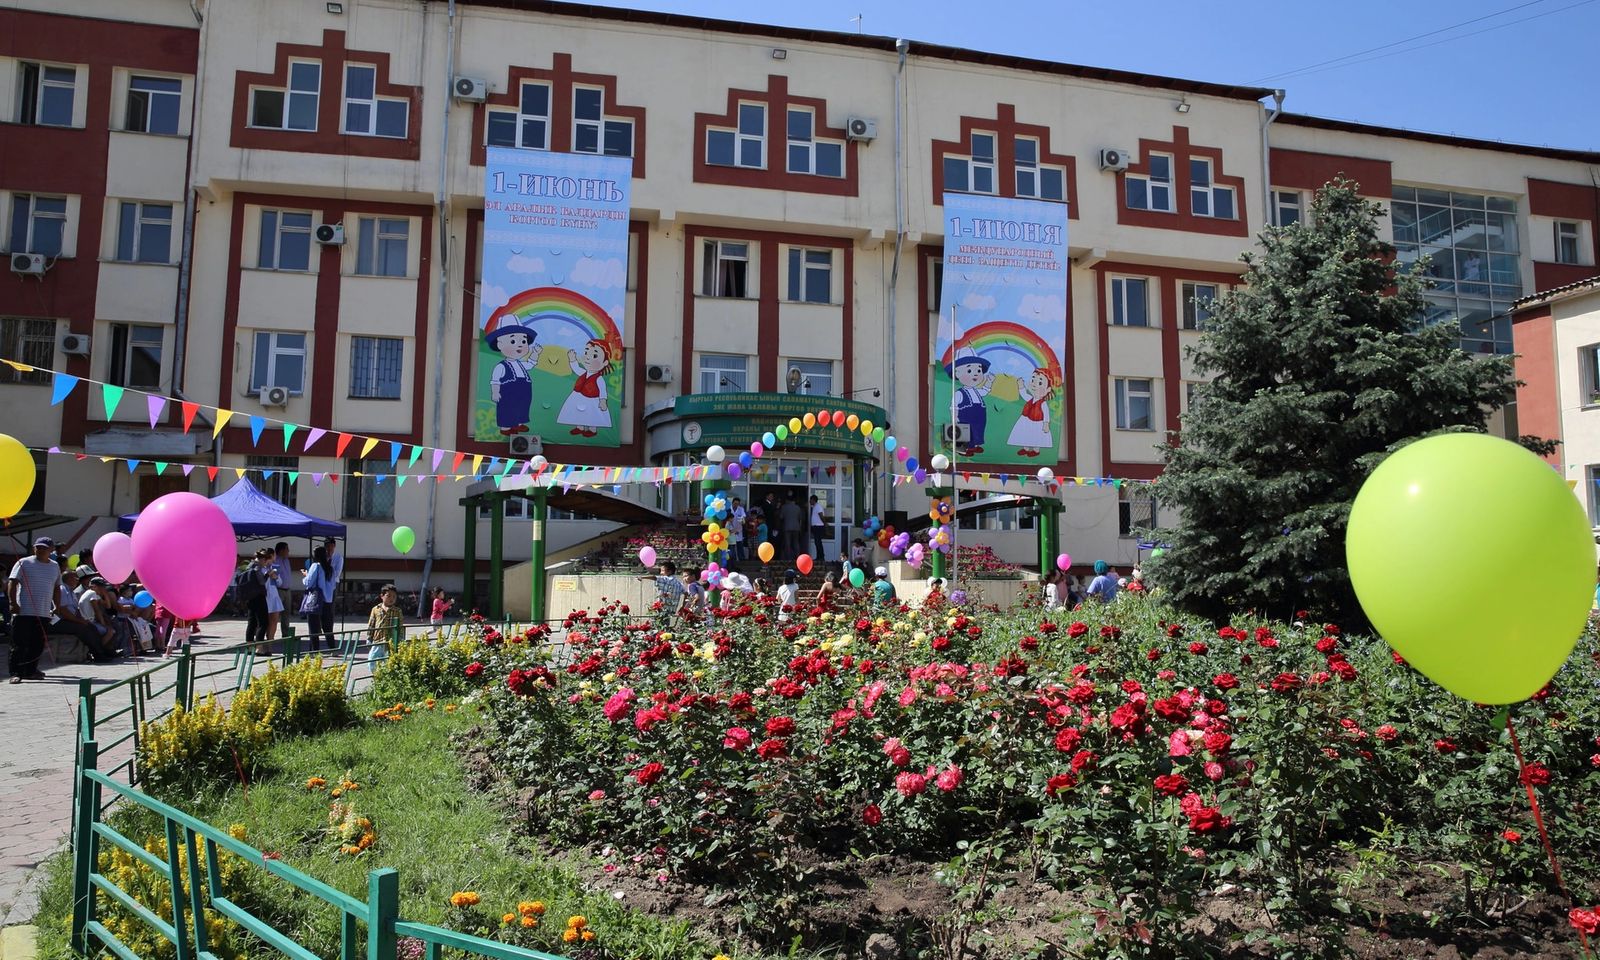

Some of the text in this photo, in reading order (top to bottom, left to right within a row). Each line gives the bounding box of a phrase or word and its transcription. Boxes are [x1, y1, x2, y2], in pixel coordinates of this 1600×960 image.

[493, 172, 624, 202] 1-ИЮНЬ
[505, 203, 557, 214] АРАЛЫК
[951, 217, 1062, 245] 1-ИЮНЯ
[960, 245, 1054, 259] МЕЖДУНАРОДНЫЙ
[949, 255, 975, 264] ДЕНЬ
[979, 257, 1024, 268] ЗАЩИТЫ
